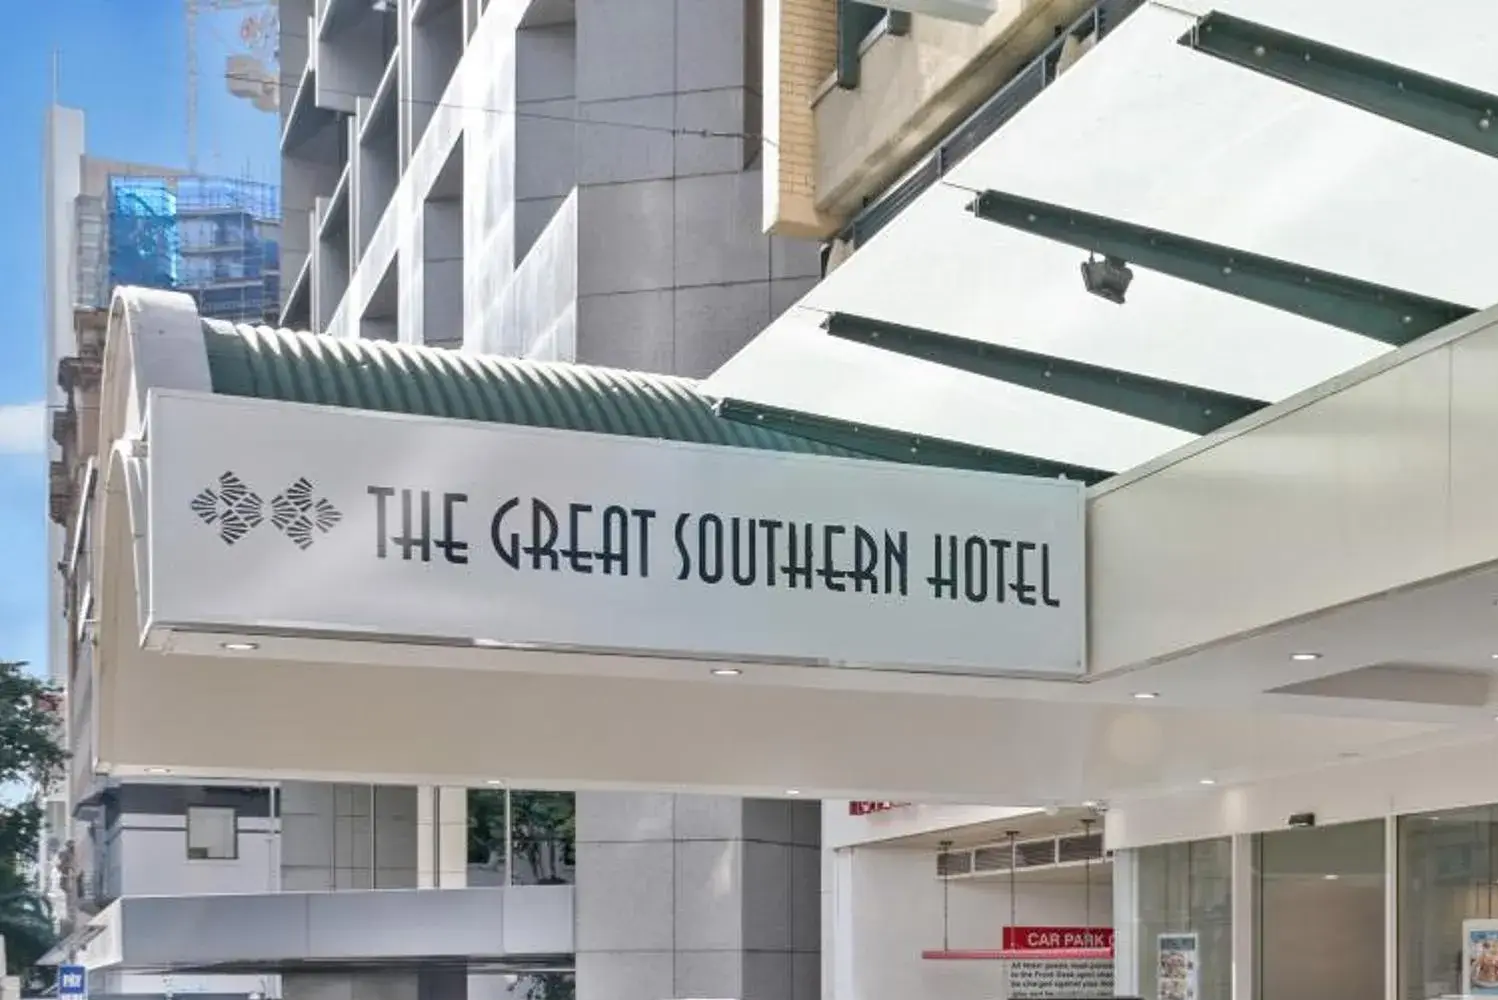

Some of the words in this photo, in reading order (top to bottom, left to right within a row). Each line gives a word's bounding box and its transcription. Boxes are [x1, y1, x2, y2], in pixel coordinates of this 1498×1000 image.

[367, 486, 469, 565] THE
[491, 497, 656, 578] GREAT
[674, 512, 908, 596] SOUTHERN
[926, 533, 1060, 608] HOTEL
[1027, 932, 1060, 947] CAR
[1064, 932, 1104, 947] PARK
